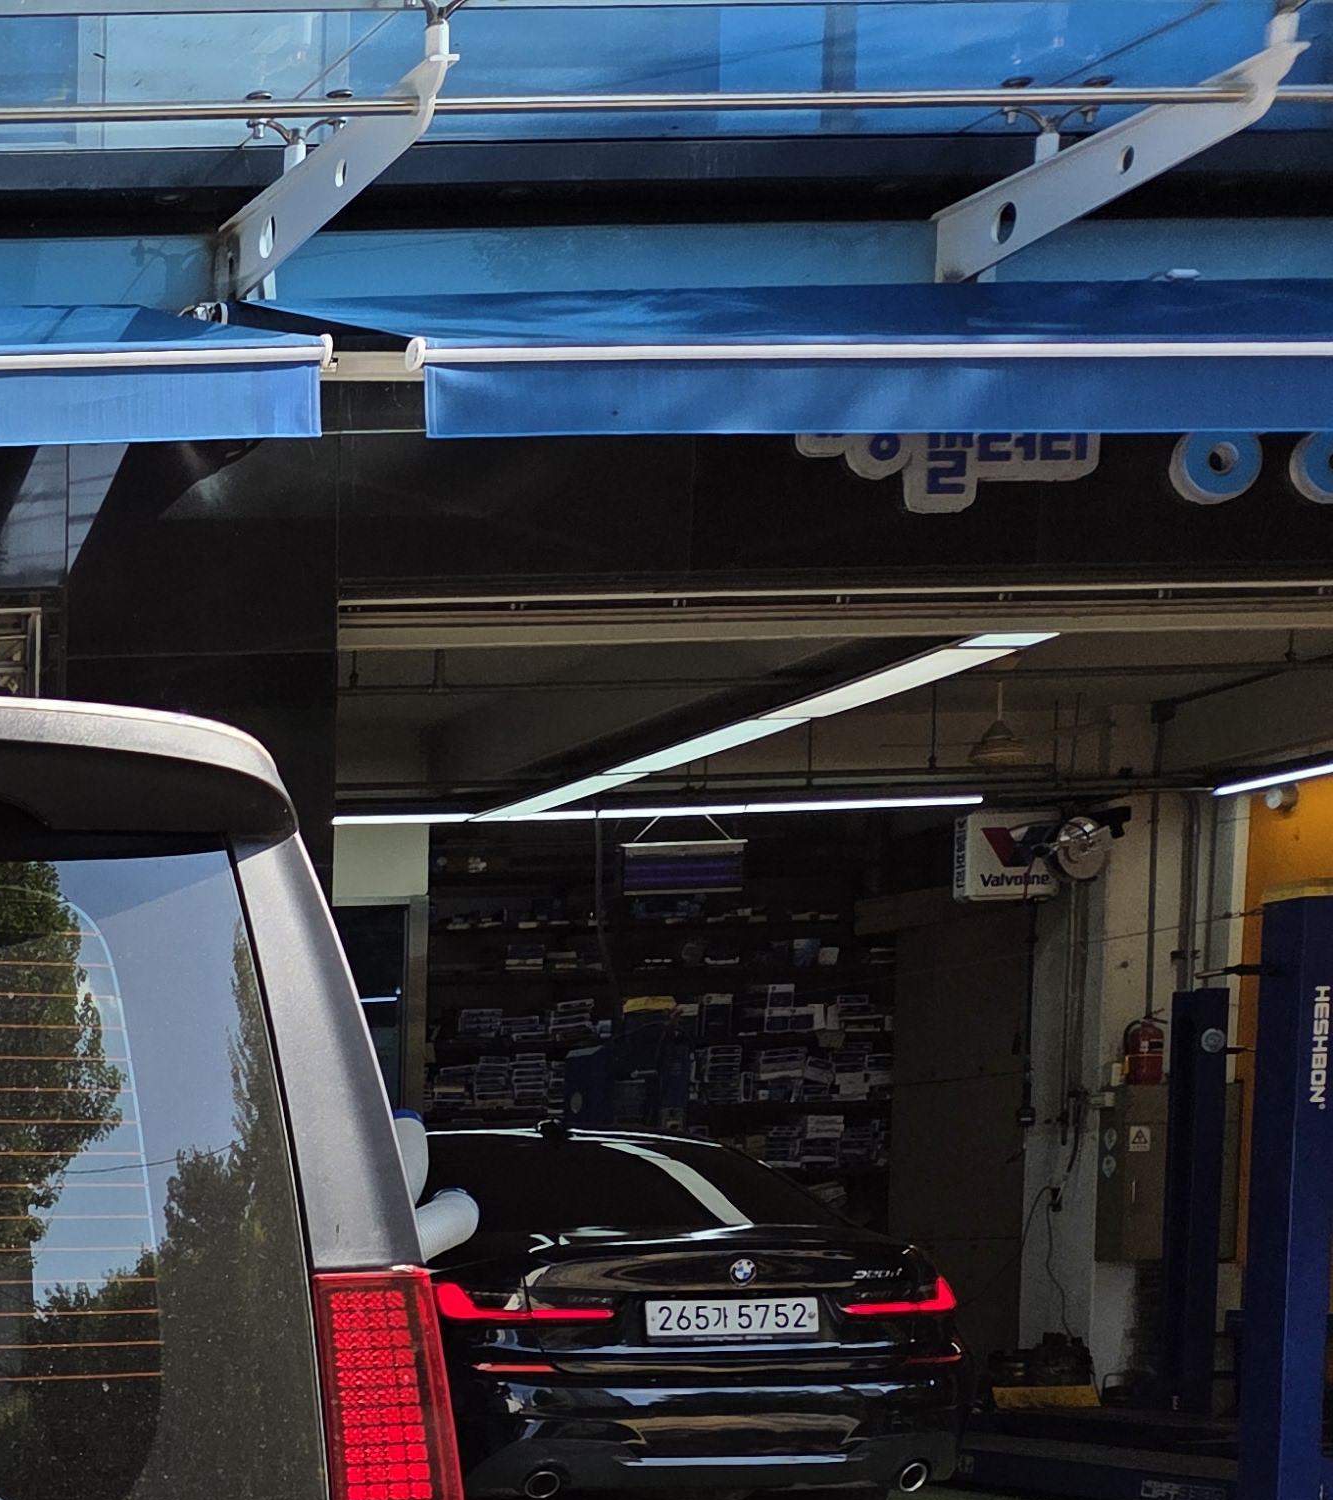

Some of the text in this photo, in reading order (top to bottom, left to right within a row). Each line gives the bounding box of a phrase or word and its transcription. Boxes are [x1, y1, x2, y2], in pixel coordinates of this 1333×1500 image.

[1309, 985, 1331, 1104] HESHBON
[658, 1302, 808, 1331] 265가 5752
